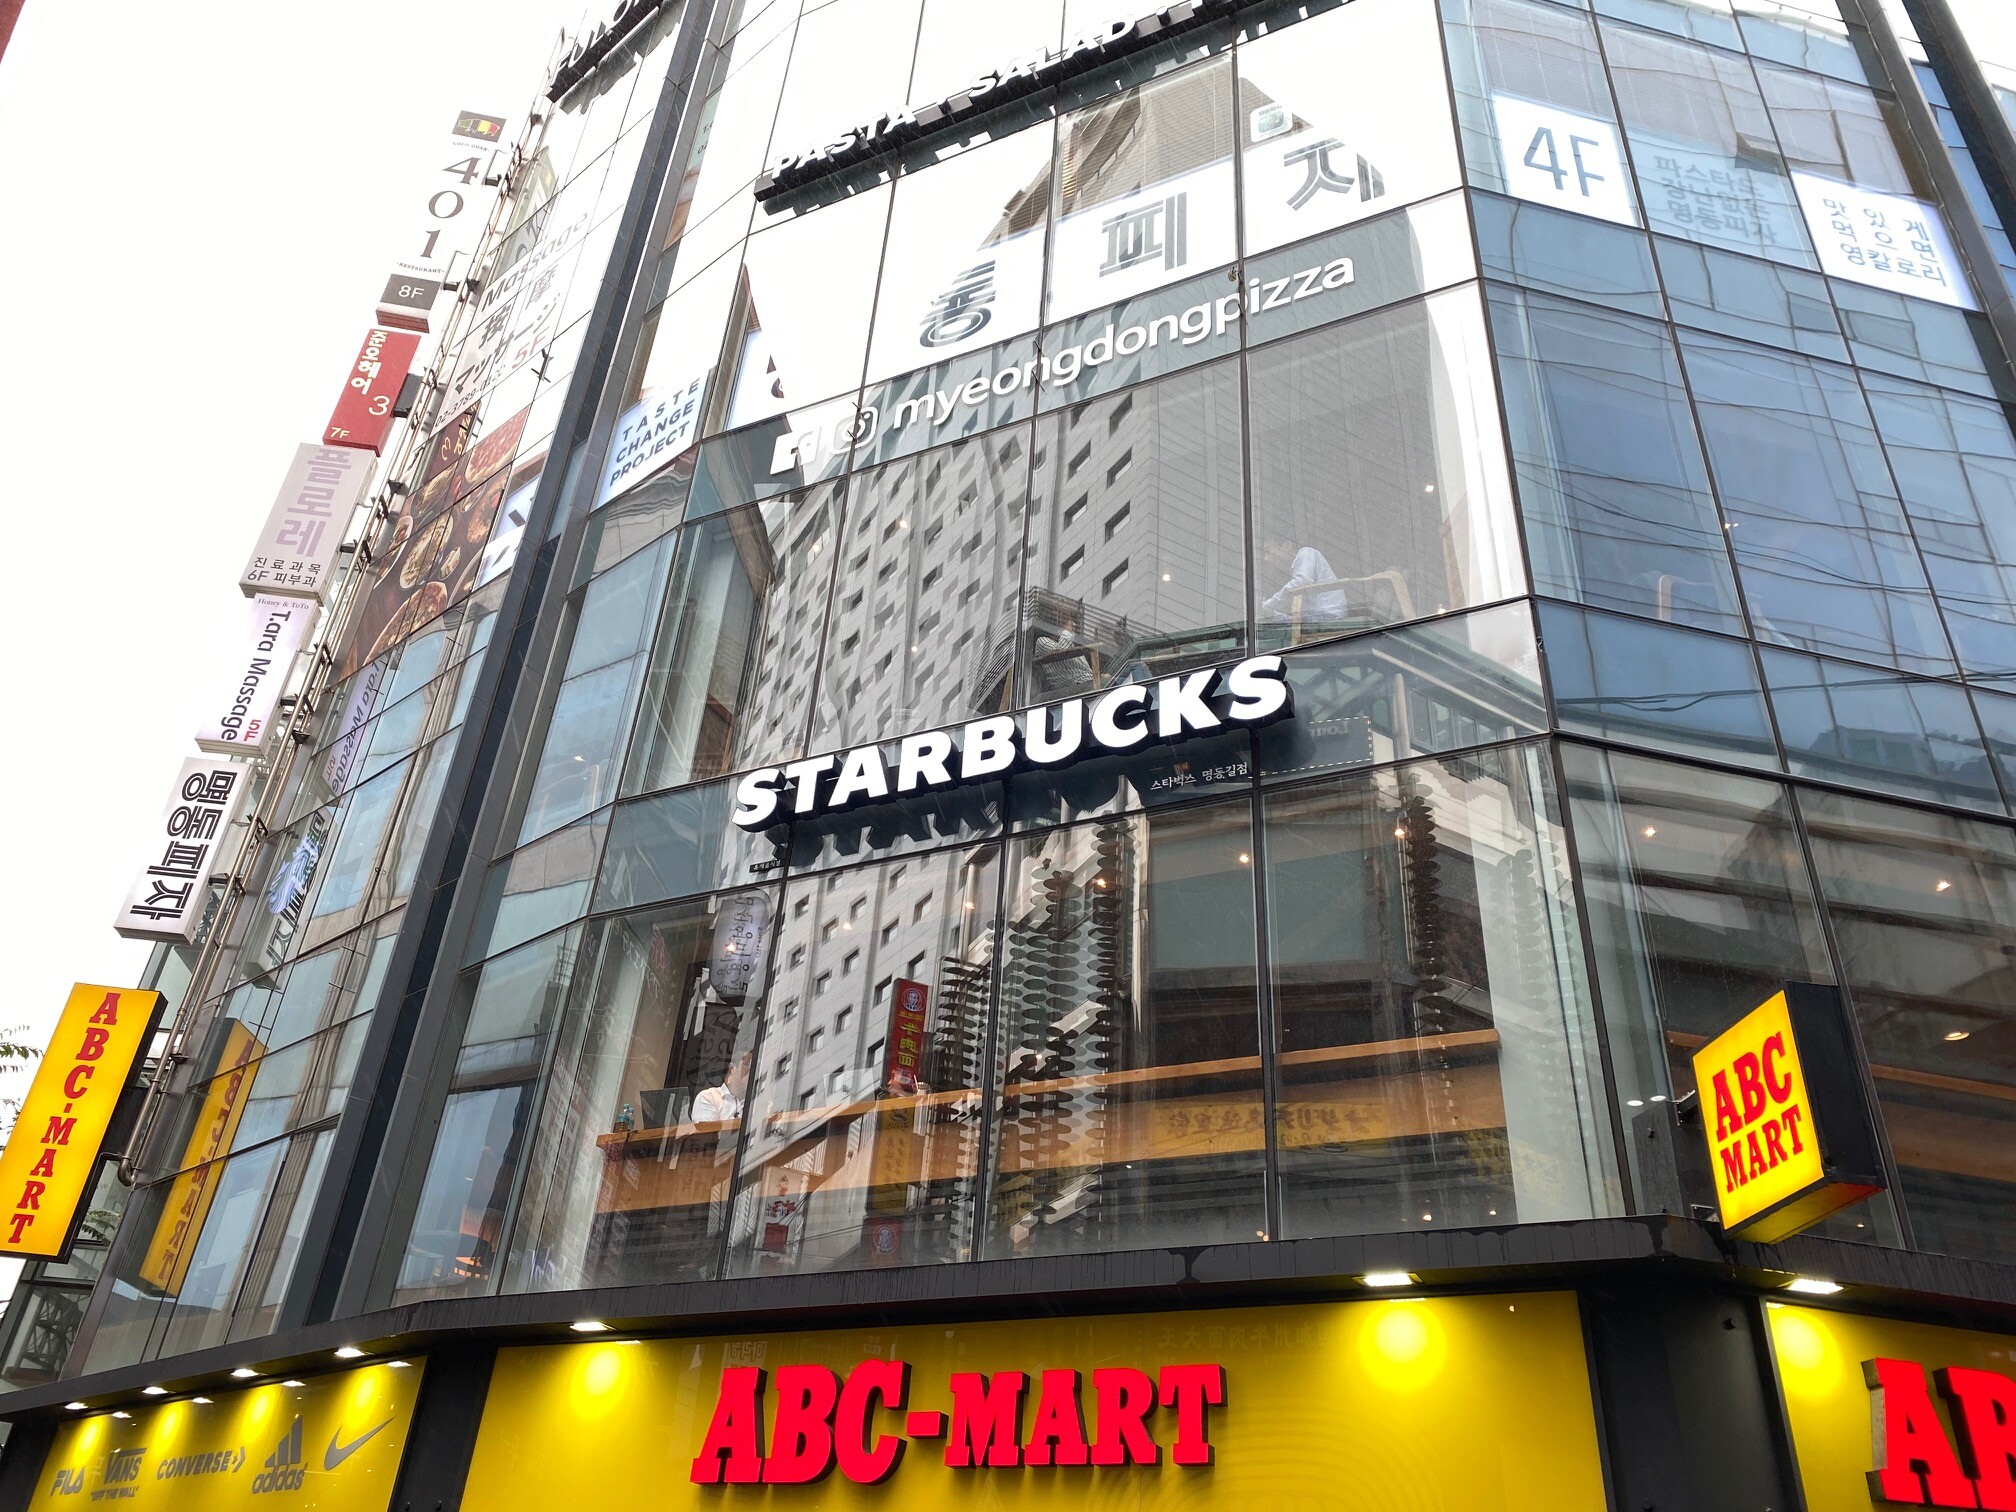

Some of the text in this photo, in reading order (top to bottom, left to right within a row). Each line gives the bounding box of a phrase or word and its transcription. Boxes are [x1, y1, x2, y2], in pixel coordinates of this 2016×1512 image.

[770, 14, 1139, 182] PASTA SALAD
[1523, 126, 1605, 196] 4F
[397, 262, 444, 274] RESTAURANT
[398, 285, 425, 300] 8F
[1840, 243, 1947, 288] 영칼로리
[350, 330, 388, 395] 준오헤어
[512, 325, 551, 369] 5F
[893, 253, 1356, 431] myeongdongpizza
[330, 427, 350, 439] 7F
[368, 395, 391, 416] 3
[616, 399, 695, 464] CHANGE
[622, 377, 701, 443] TASTE
[609, 421, 691, 487] PROJECT
[276, 449, 352, 558] 플로레
[247, 569, 317, 588] 6F 피부과
[253, 556, 322, 575] 진료과목
[257, 598, 282, 609] Honey
[291, 602, 310, 610] ToTo
[221, 611, 292, 742] T.ara Massage
[243, 719, 262, 742] 5F
[730, 655, 1291, 828] STARBUCKS
[1150, 762, 1249, 791] 스타벅스 명동길점
[129, 769, 238, 921] 명동피자
[1711, 1030, 1793, 1143] ABC
[8, 991, 122, 1245] ABC-MART
[1719, 1103, 1804, 1194] MART
[690, 1358, 1228, 1486] ABC-MART
[50, 1466, 84, 1497] FILA
[103, 1446, 147, 1485] VANS
[156, 1450, 234, 1480] CONVERSE
[251, 1465, 305, 1495] adidas
